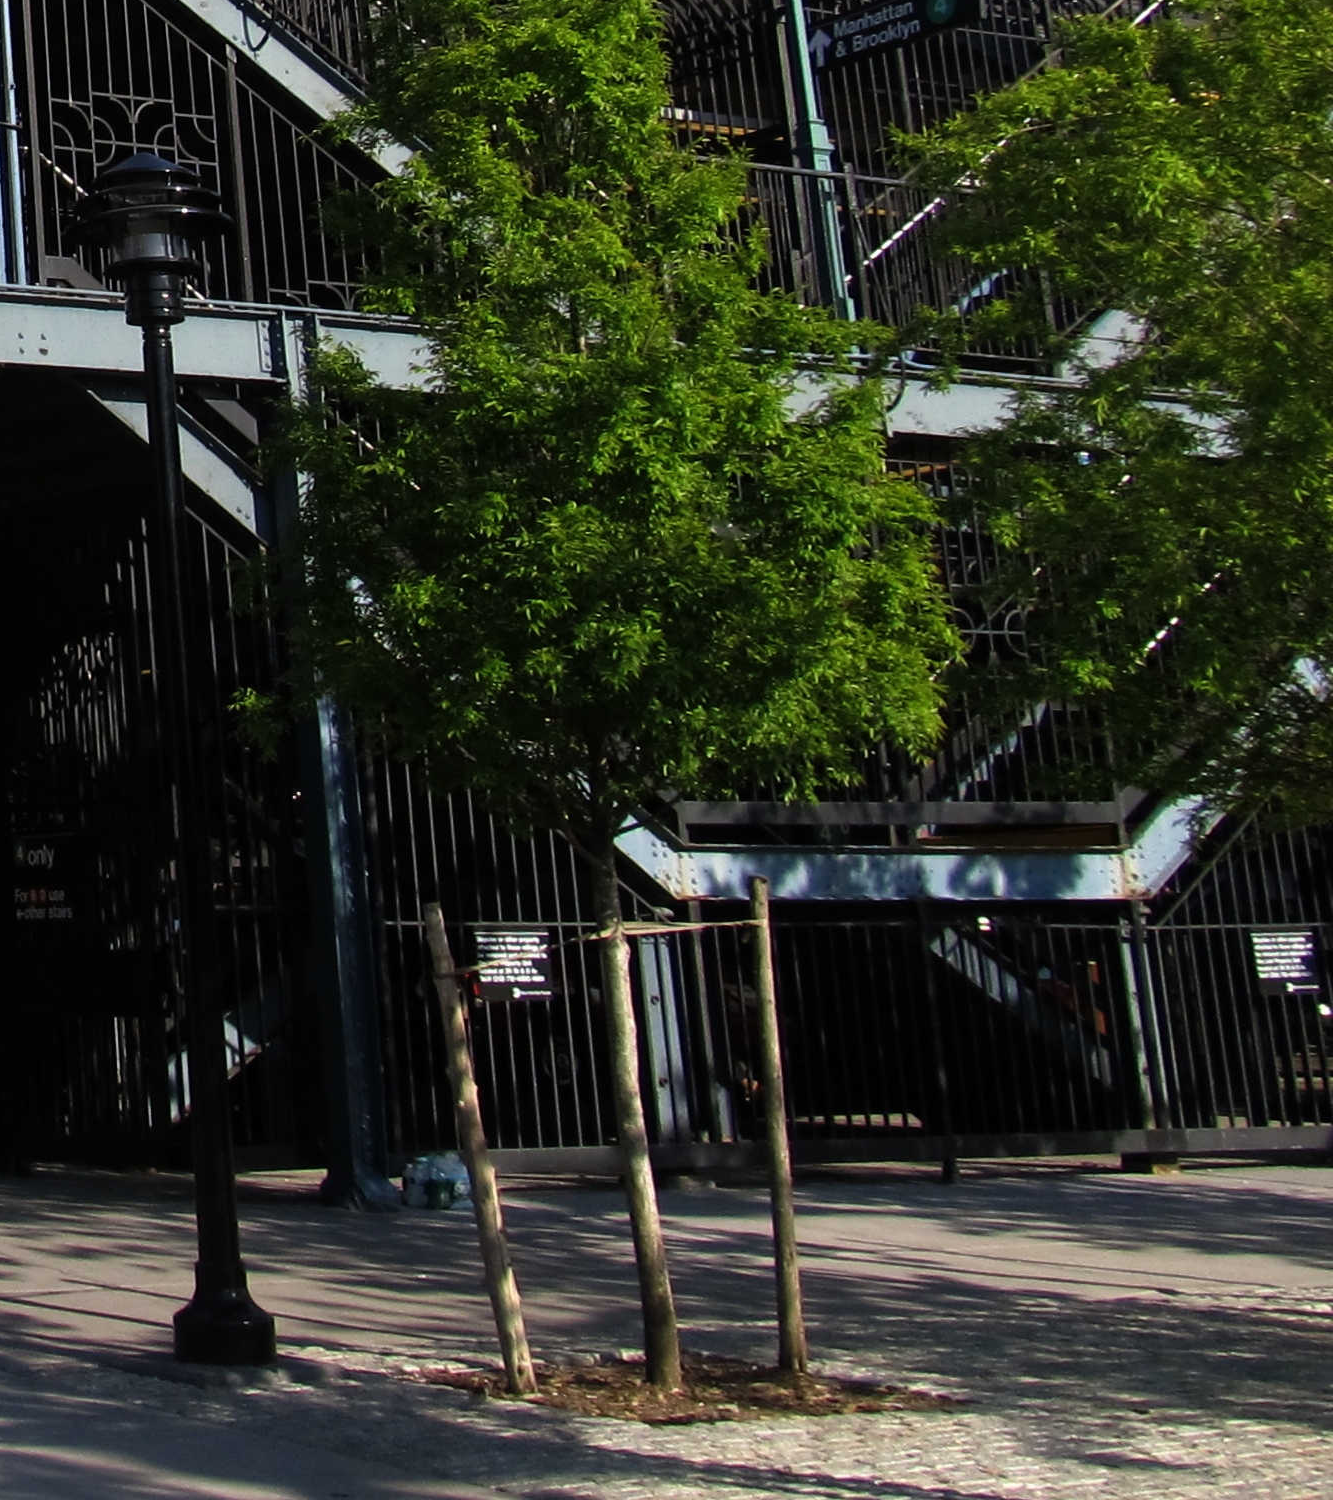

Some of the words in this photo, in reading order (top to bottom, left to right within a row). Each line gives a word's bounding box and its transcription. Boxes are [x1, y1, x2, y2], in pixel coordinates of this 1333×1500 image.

[834, 1, 914, 39] Manhattan
[835, 40, 848, 58] &
[852, 18, 921, 51] Brooklyn
[15, 845, 26, 860] 4
[27, 842, 55, 869] only
[48, 889, 65, 901] use
[48, 905, 73, 919] stairs
